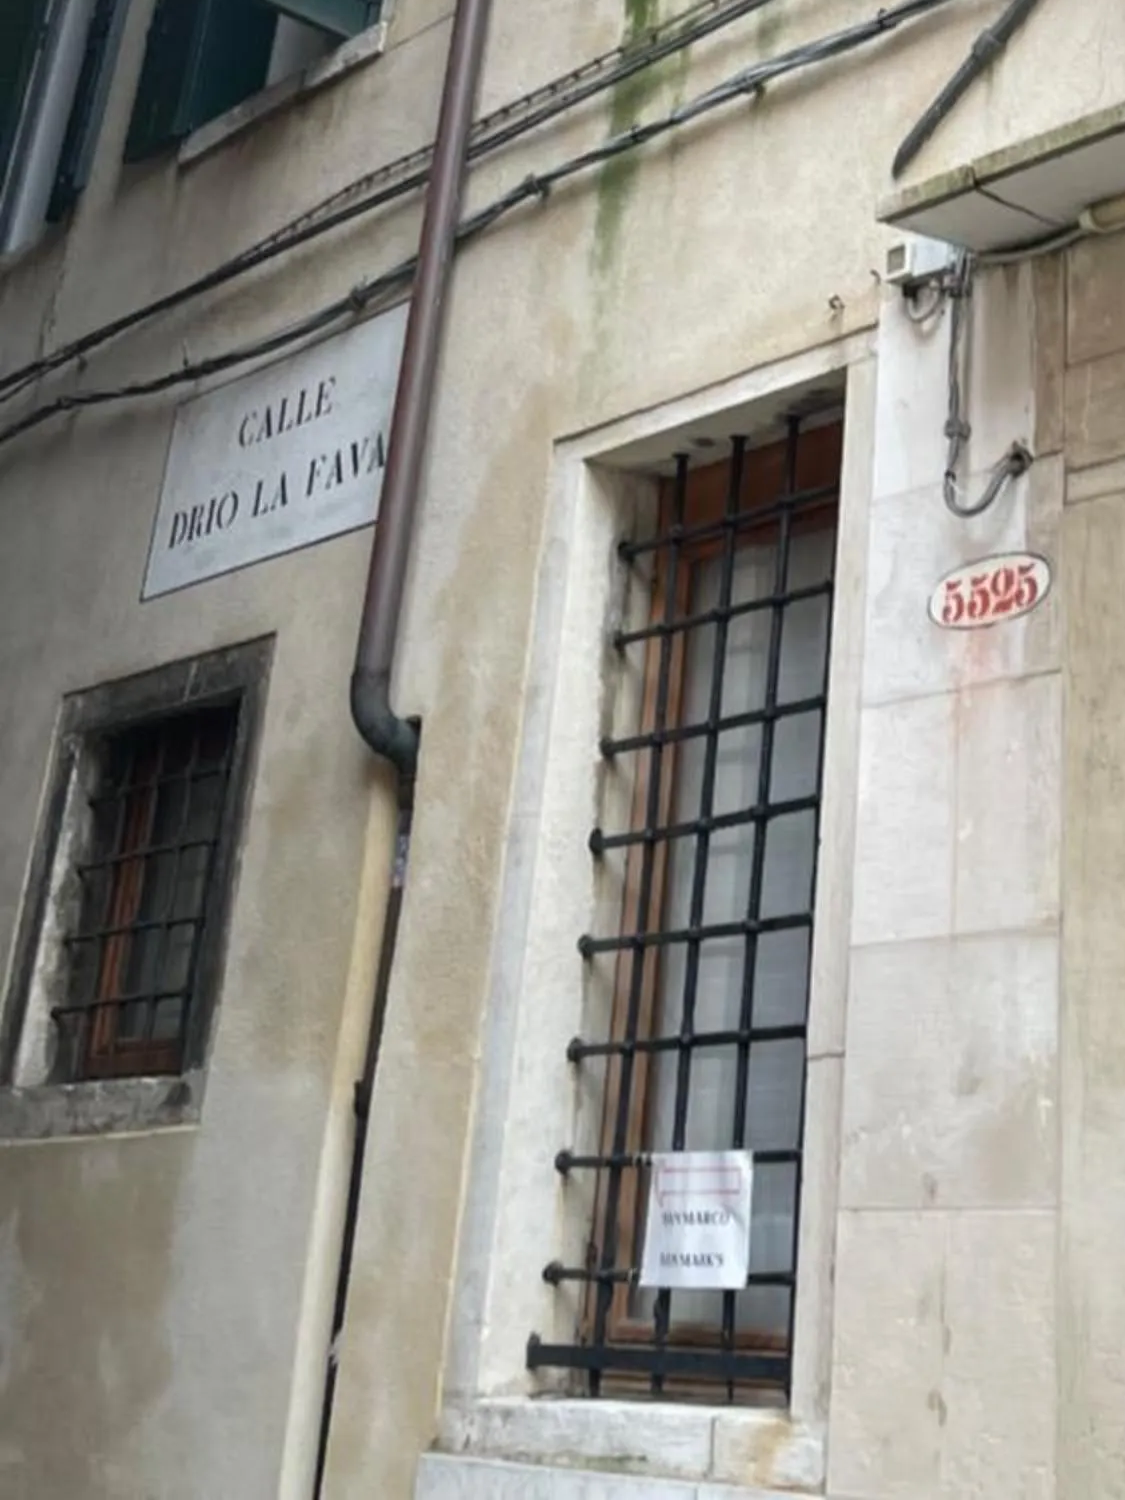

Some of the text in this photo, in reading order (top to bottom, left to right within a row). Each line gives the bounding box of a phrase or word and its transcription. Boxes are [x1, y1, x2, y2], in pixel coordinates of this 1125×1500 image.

[238, 376, 336, 448] CALLE
[169, 431, 386, 549] DRIO LA FAVA
[682, 1210, 730, 1226] MARCO
